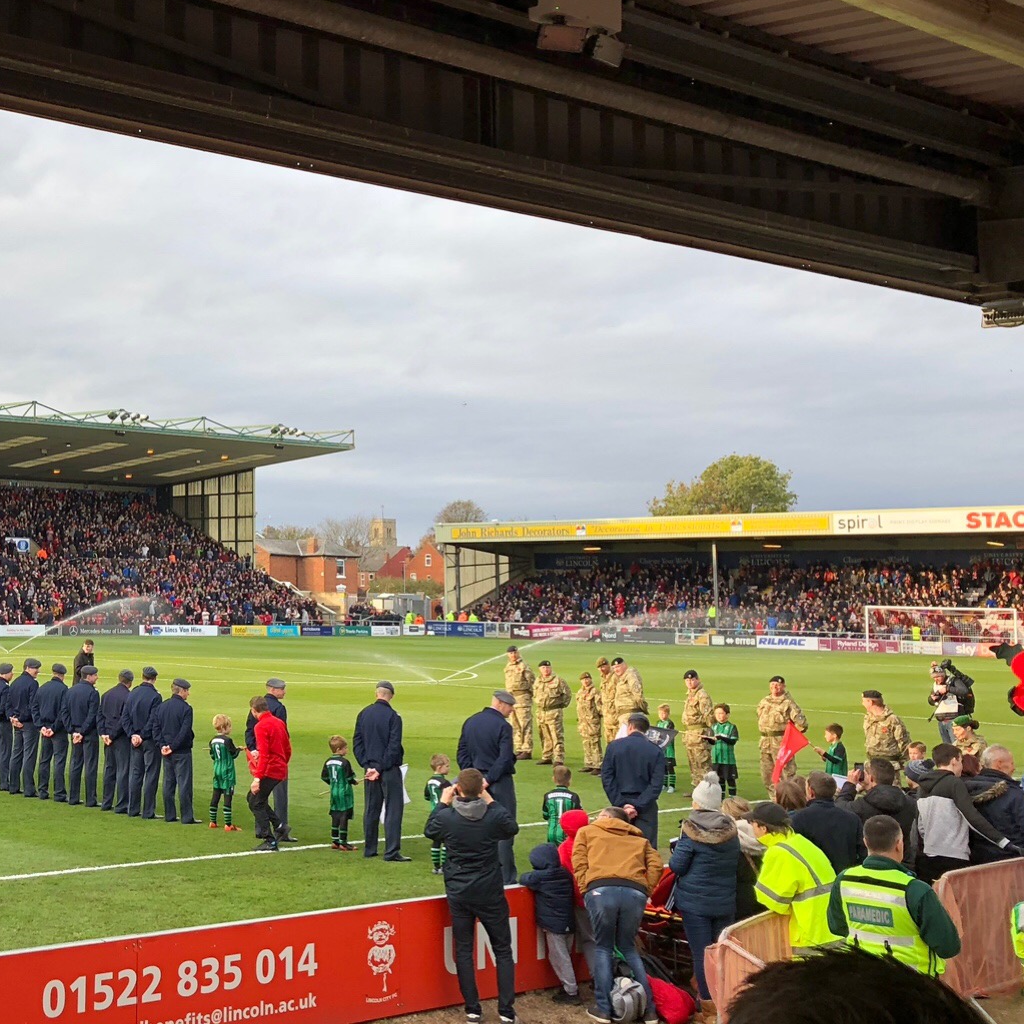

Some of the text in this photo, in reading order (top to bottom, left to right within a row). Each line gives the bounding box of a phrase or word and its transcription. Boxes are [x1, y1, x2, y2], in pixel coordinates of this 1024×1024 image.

[838, 514, 883, 532] spiral
[458, 525, 570, 538] John Richards Decorators
[602, 632, 616, 640] Njord
[758, 638, 806, 646] RILMAC
[837, 640, 858, 648] Ryland
[956, 644, 976, 656] sky
[214, 744, 221, 759] 6
[331, 766, 338, 782] 4
[431, 784, 438, 804] 5
[848, 904, 892, 926] PARAMEDIC
[42, 942, 318, 1019] 01522 835 014
